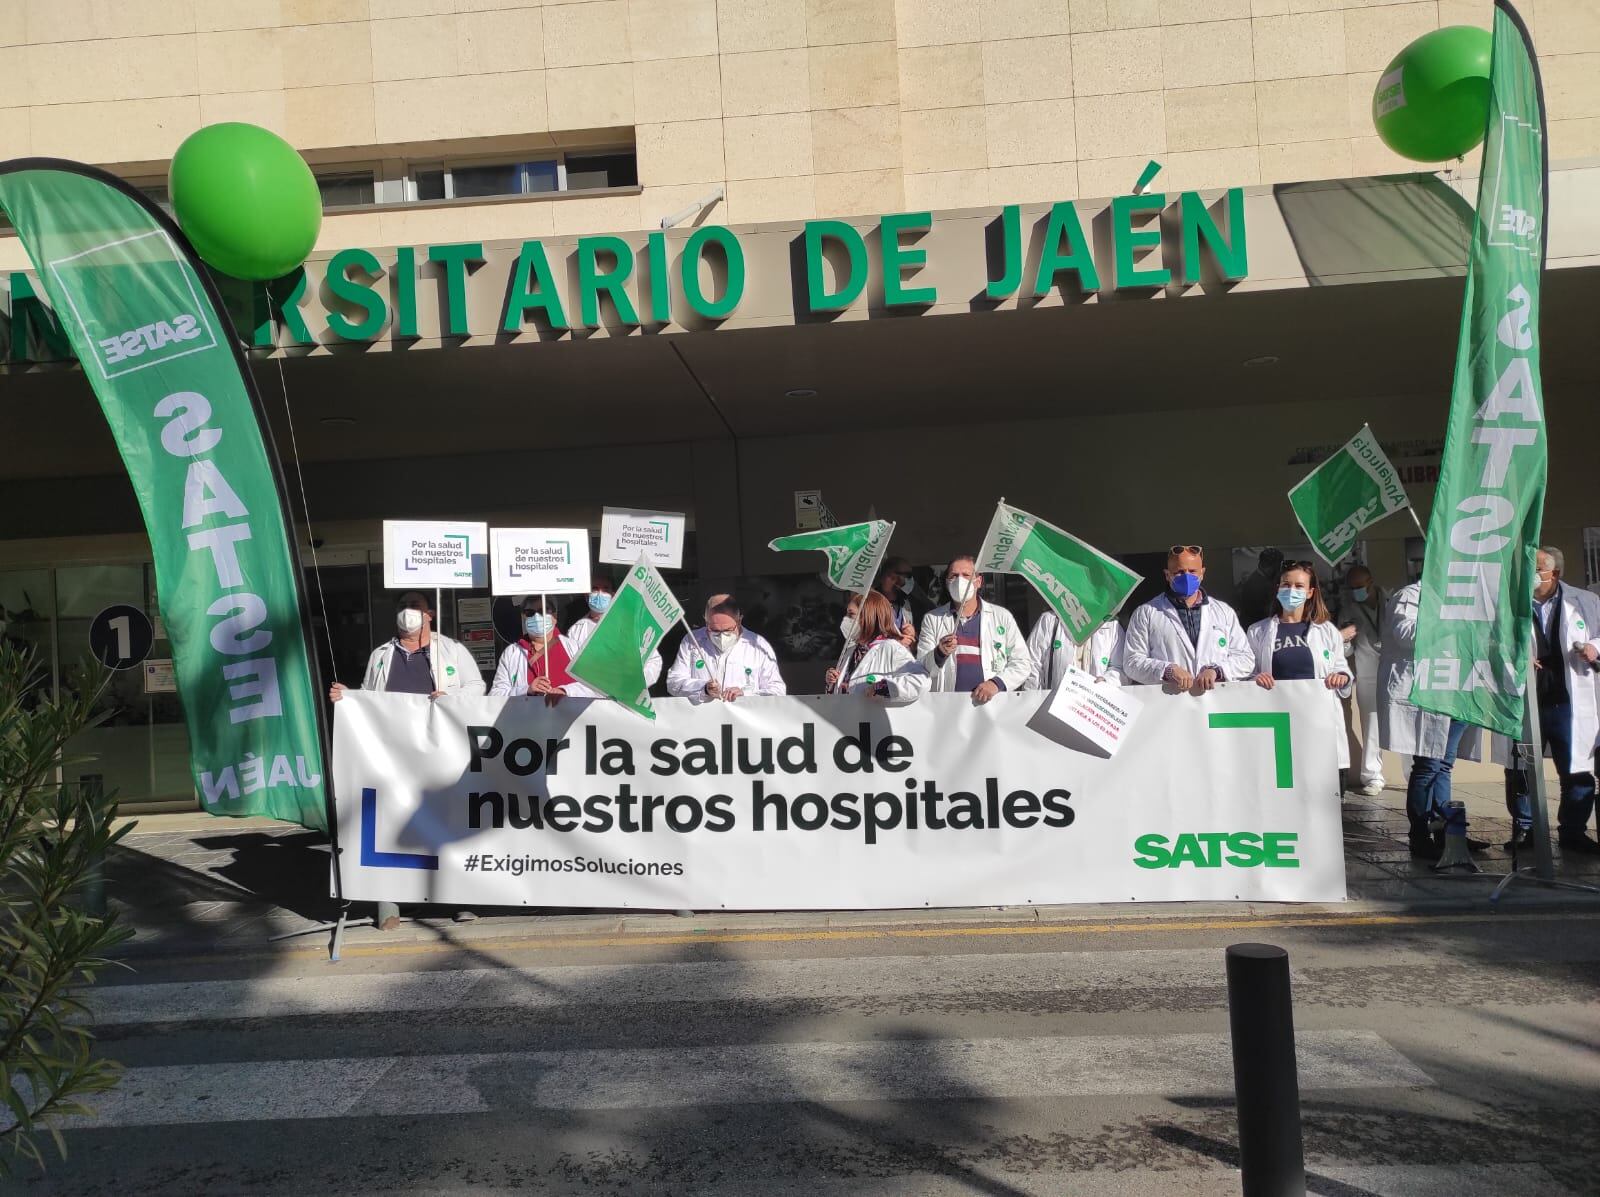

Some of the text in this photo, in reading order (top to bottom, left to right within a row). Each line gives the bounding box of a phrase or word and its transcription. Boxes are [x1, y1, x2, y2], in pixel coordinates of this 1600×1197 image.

[804, 212, 937, 312] DE
[986, 160, 1248, 300] JAÉN
[643, 526, 663, 534] salud
[411, 540, 462, 550] Por la salud
[514, 546, 563, 555] Por la salud
[621, 538, 658, 546] hospitales
[411, 556, 457, 566] hospitales
[515, 563, 559, 572] hospitales
[528, 555, 565, 563] nuestros
[1021, 557, 1092, 633] SATSE
[108, 615, 132, 659] 1
[467, 722, 914, 776] Por la salud de
[468, 777, 1075, 844] nuestros hospitales
[1132, 831, 1300, 870] SATSE
[464, 853, 684, 877] #ExigimosSoluciones
